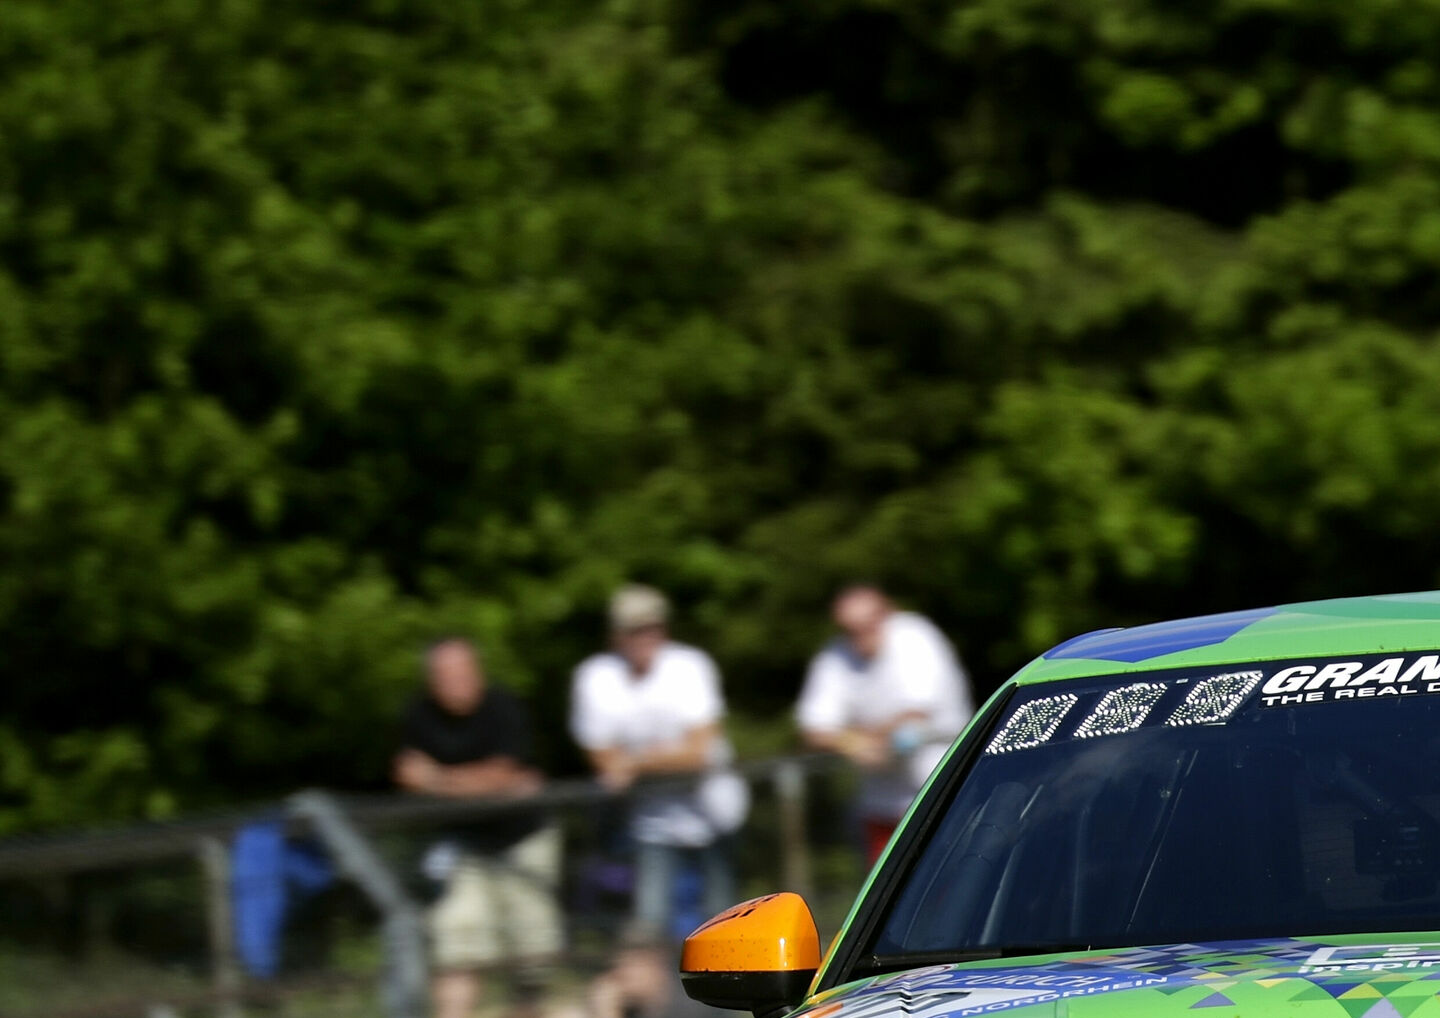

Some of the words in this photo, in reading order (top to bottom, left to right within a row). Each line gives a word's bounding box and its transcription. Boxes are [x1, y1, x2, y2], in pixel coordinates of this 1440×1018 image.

[1262, 692, 1324, 706] THE
[1335, 688, 1417, 700] REAL
[941, 974, 1112, 988] ZURICH
[962, 976, 1169, 1016] NORDRHEIN
